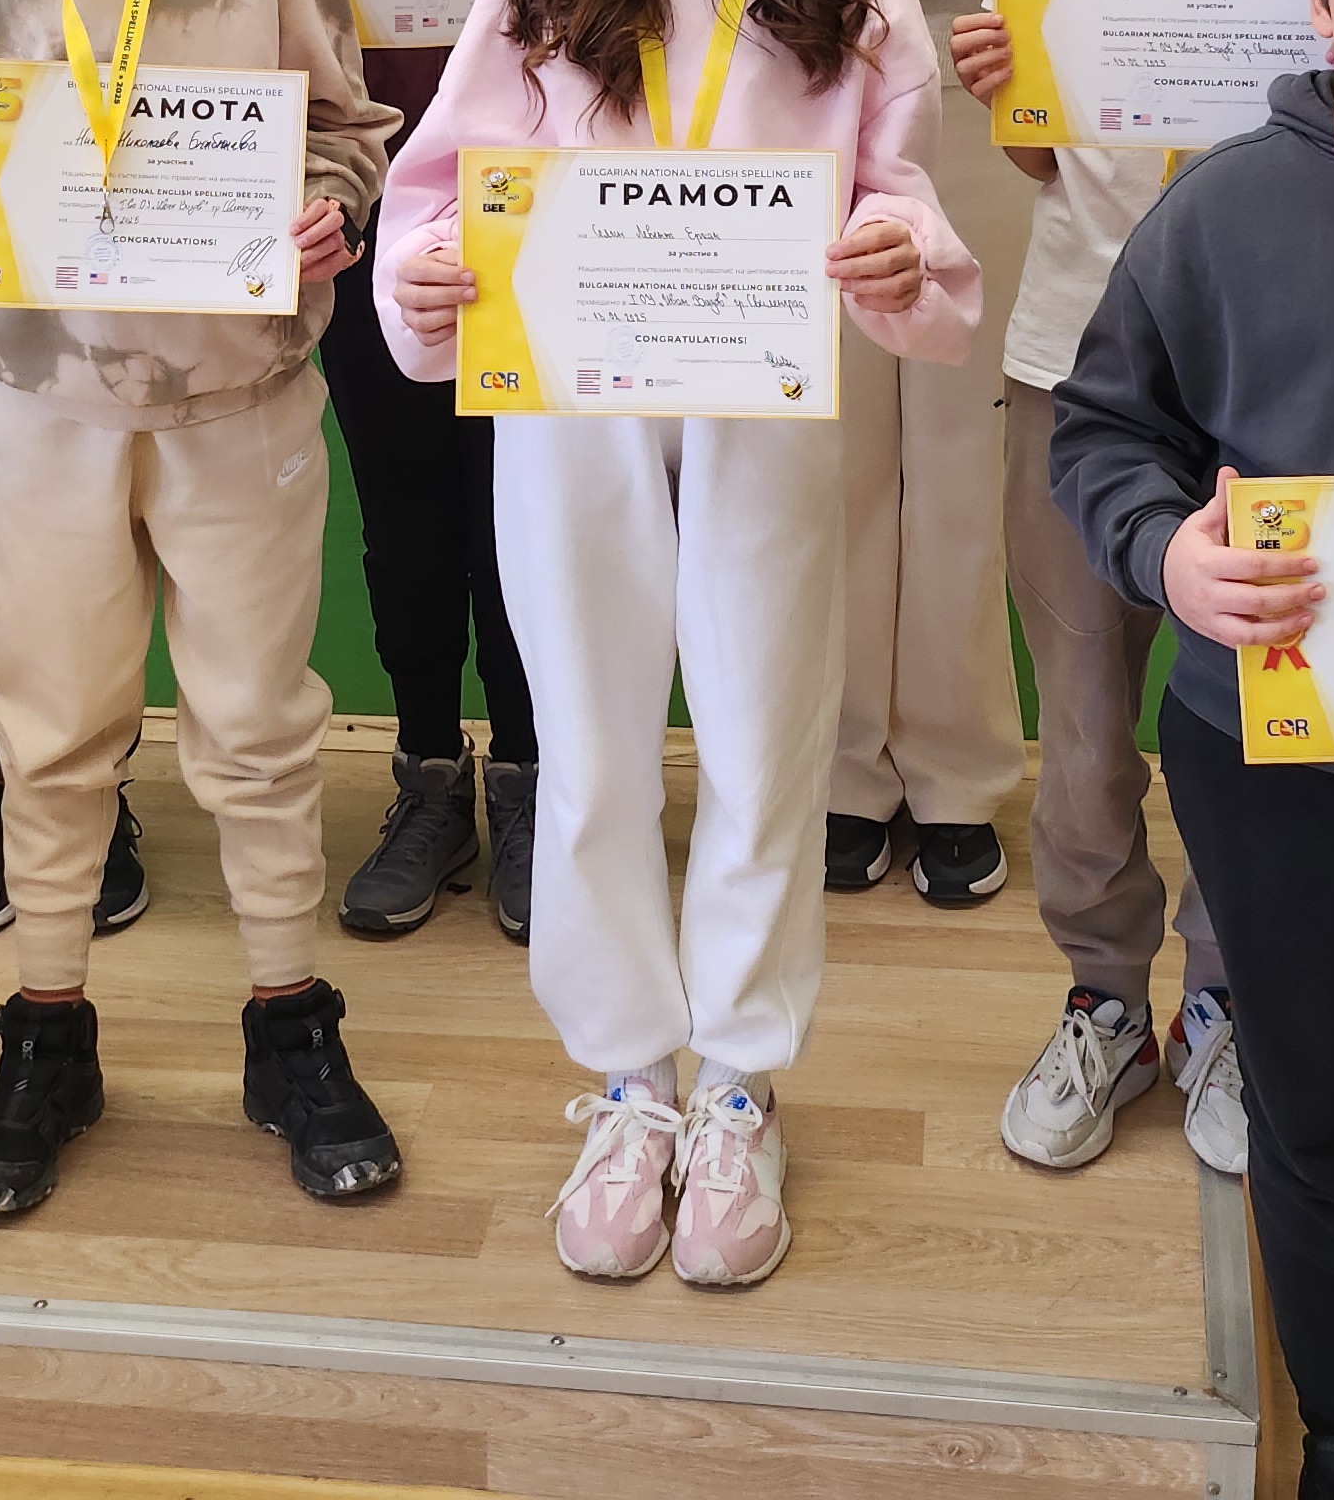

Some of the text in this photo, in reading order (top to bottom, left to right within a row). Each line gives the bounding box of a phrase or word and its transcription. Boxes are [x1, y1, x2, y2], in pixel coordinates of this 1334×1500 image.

[123, 9, 139, 52] SPELLING
[118, 53, 129, 73] BEE
[131, 83, 284, 97] ATIONAL ENGLISH SPELLING BEE
[1154, 78, 1259, 88] CONGRATULATIONS!
[113, 81, 124, 105] 2025
[130, 96, 265, 122] АМОТА
[579, 167, 814, 179] BULGARIAN NATIONAL ENGLISH SPELLING BEE
[599, 182, 794, 207] ГРАМОТА
[112, 235, 217, 247] CONGRATULATIONS!
[579, 281, 630, 290] BULGARIAN
[633, 281, 678, 290] NATIONAL
[680, 282, 718, 291] ENGLISH
[720, 283, 763, 292] SPELLING
[766, 284, 783, 292] BEE
[635, 334, 748, 346] CONGRATULATIONS!
